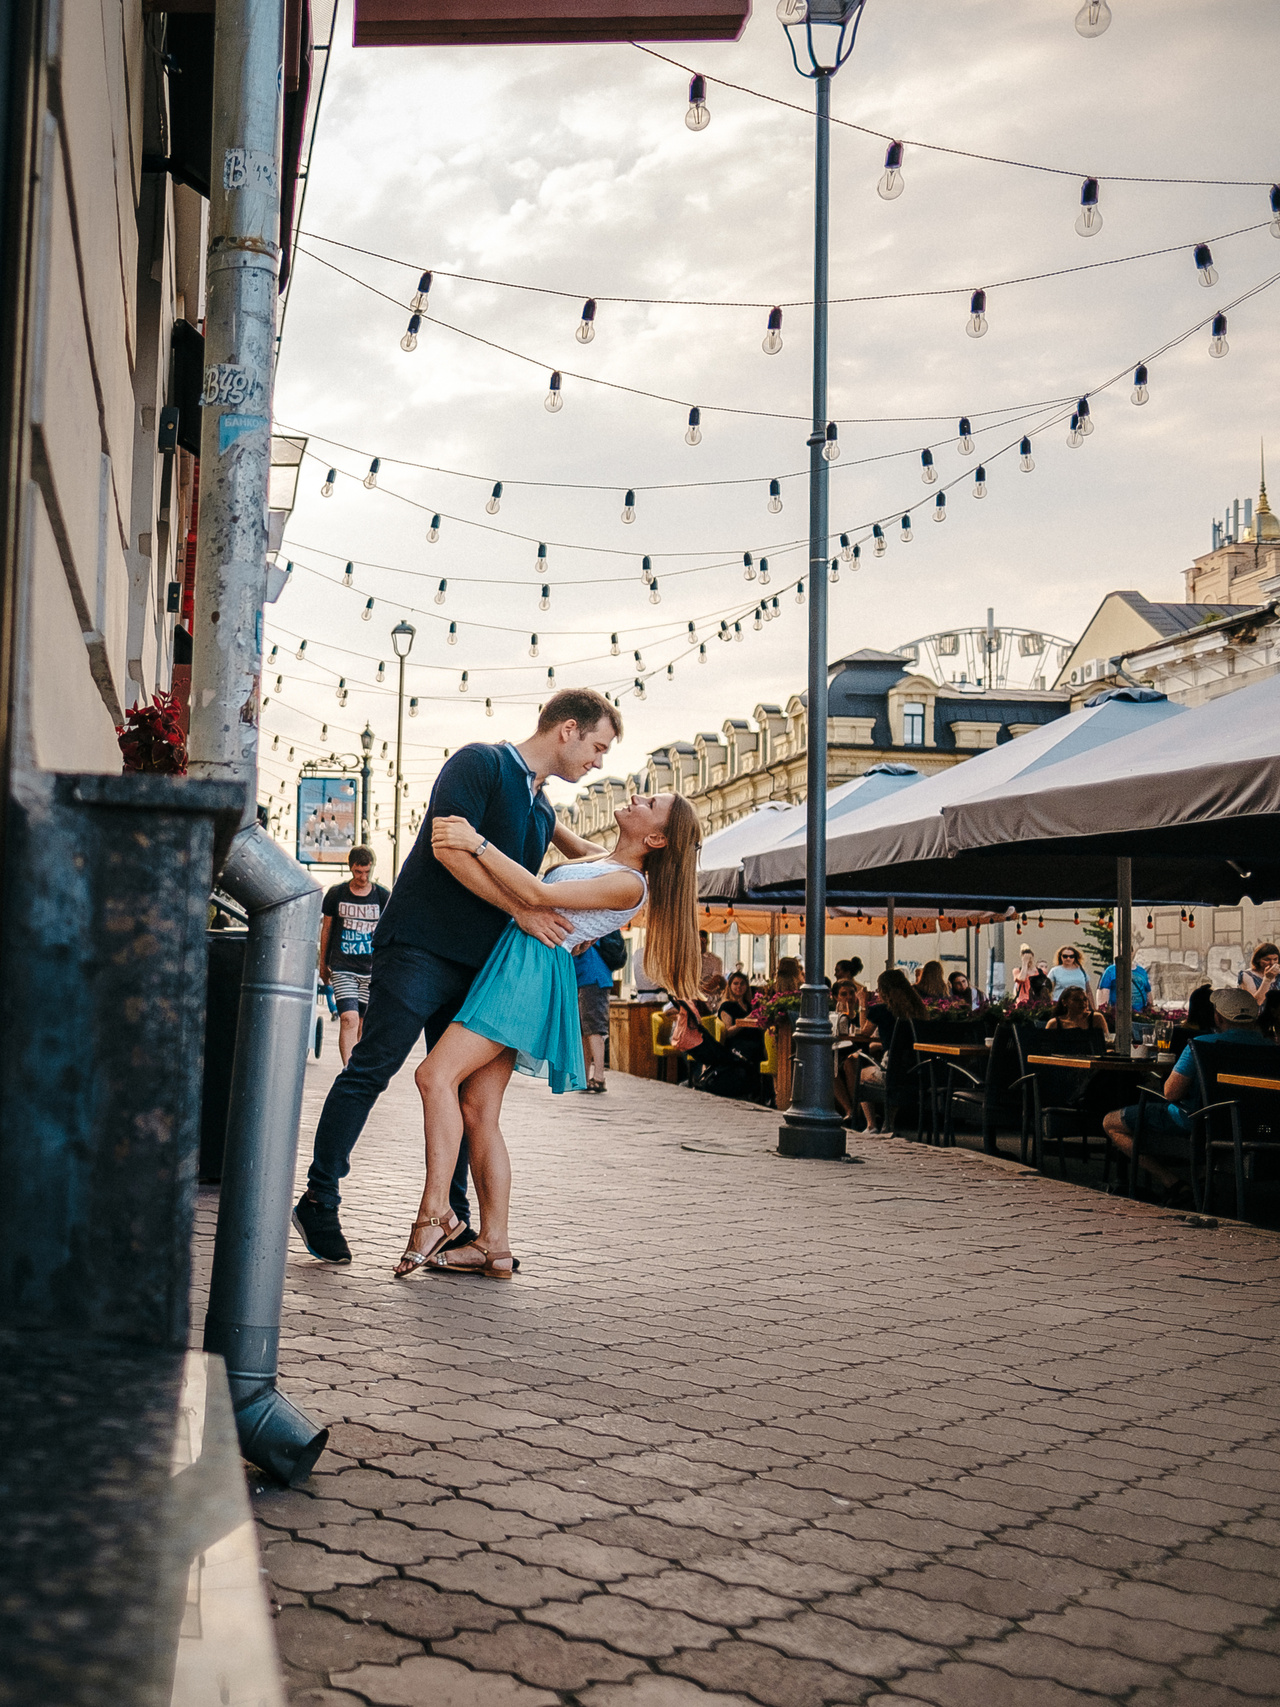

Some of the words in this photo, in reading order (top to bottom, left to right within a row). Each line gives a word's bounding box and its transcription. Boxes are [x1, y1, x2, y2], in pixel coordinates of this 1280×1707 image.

[340, 904, 378, 918] DON'T
[341, 930, 370, 941] JUST
[341, 941, 373, 955] SKAT
